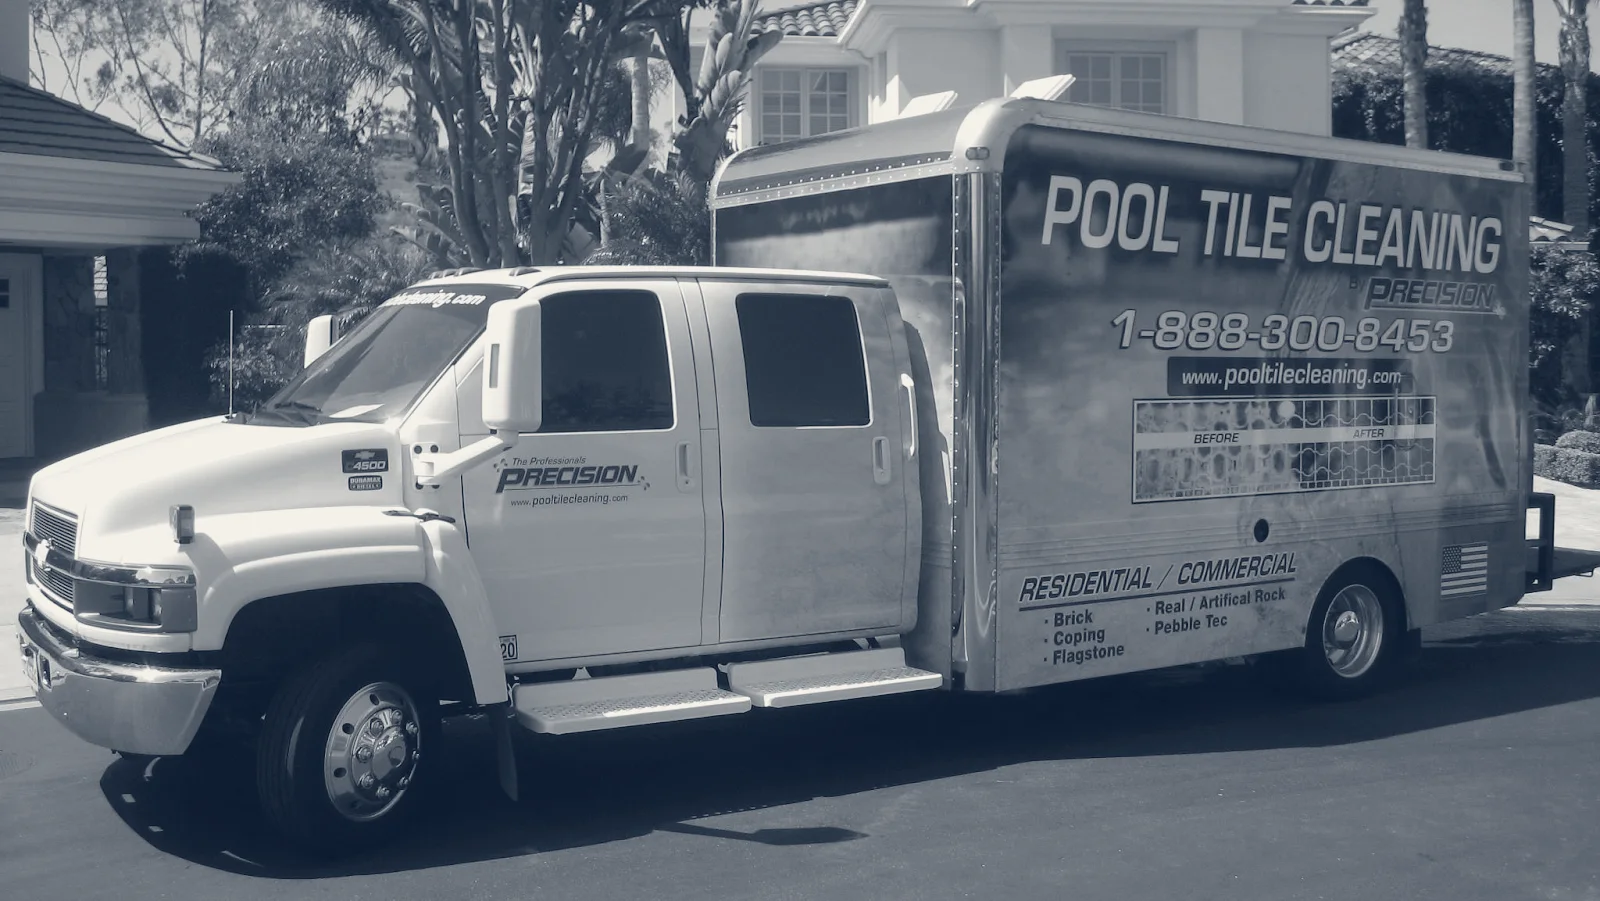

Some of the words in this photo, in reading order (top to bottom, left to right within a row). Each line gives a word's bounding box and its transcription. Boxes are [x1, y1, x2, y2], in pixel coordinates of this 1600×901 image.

[1041, 175, 1179, 253] POOL
[1200, 189, 1292, 260] TILE
[1303, 200, 1502, 274] CLEANING
[1364, 276, 1497, 311] PRECISION
[1110, 309, 1454, 352] 1-888-300-8453
[1182, 362, 1401, 390] www.pooltilecleaning.com
[1194, 432, 1239, 444] BEFORE
[1353, 428, 1385, 439] AFTER
[353, 460, 386, 471] 4500
[512, 457, 527, 466] The
[530, 456, 586, 465] Professionals
[496, 465, 638, 493] PRECISION
[511, 493, 628, 507] www.pooltilecleaning.com
[1019, 566, 1152, 601] RESIDENTIAL
[1177, 552, 1297, 585] COMMERCIAL
[1155, 600, 1186, 615] Real
[1199, 591, 1250, 609] Artifical
[1255, 587, 1286, 602] Rock
[1054, 609, 1093, 627] Brick
[1154, 617, 1201, 635] Pebble
[1206, 613, 1228, 629] Tec
[1053, 628, 1106, 647] Coping
[1053, 645, 1125, 665] Flagstone
